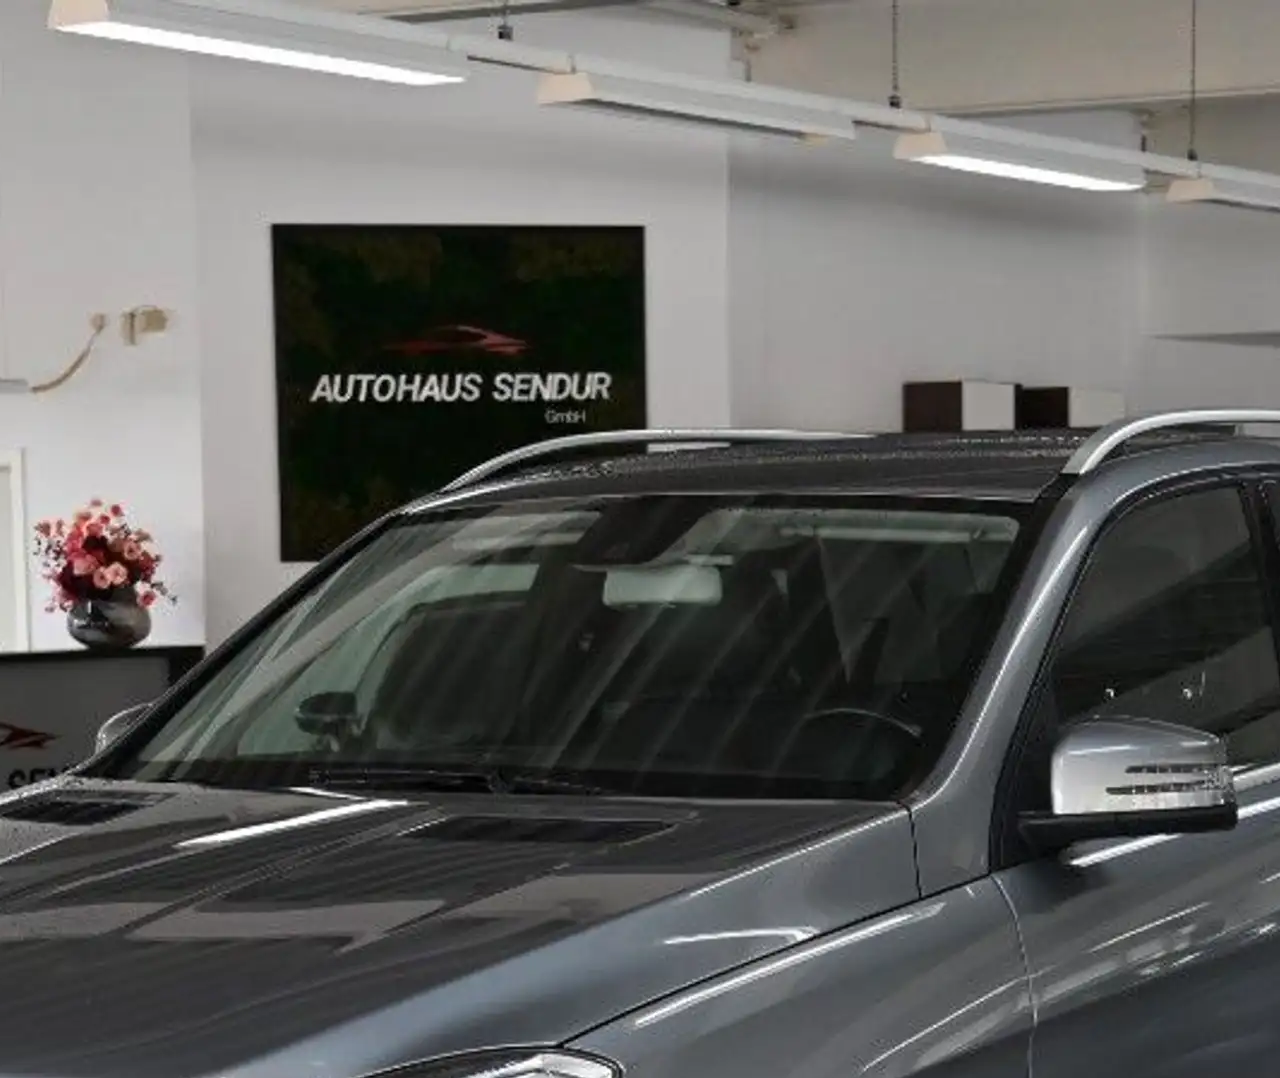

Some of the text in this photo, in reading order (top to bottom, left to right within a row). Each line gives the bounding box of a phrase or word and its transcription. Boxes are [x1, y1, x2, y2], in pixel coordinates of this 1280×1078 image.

[310, 372, 612, 402] AUTOHAUS SENDUR
[544, 408, 586, 424] GmbH
